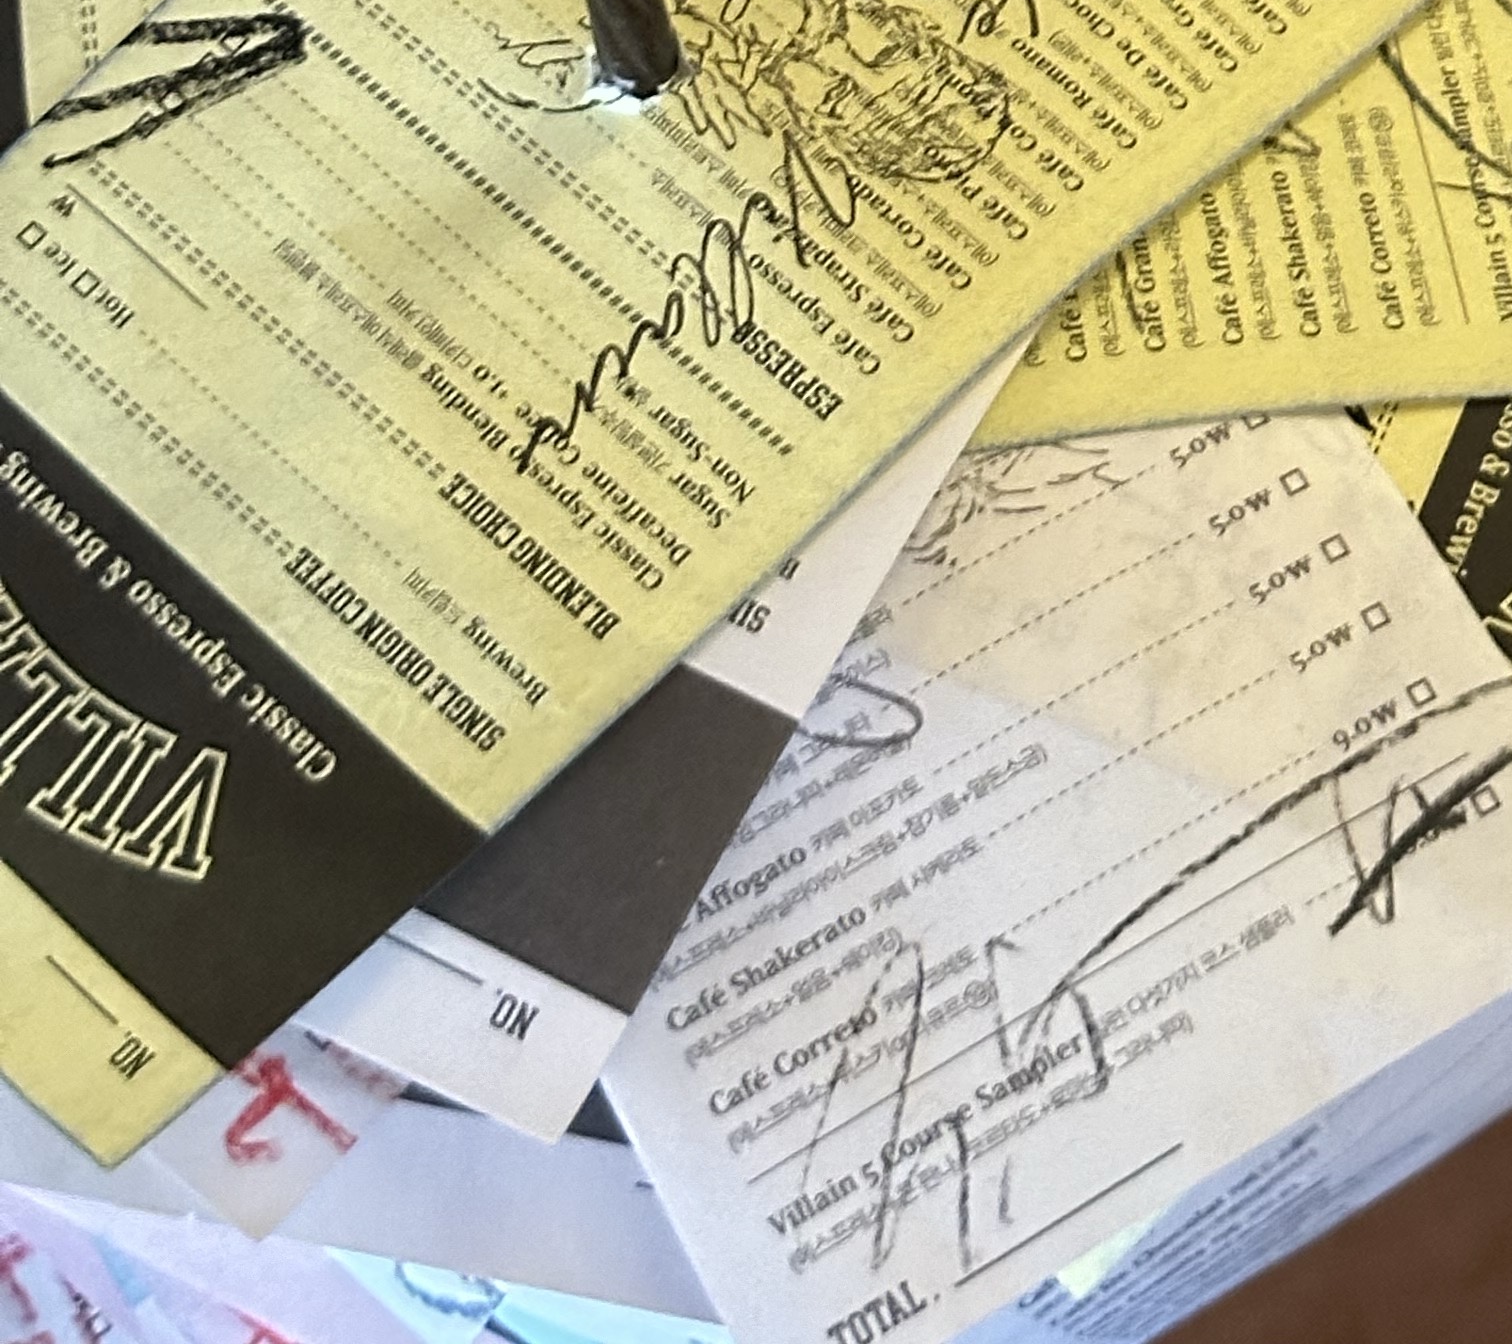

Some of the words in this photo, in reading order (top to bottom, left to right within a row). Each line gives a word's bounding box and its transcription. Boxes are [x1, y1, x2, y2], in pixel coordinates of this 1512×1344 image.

[1006, 31, 1094, 113] Romano
[1110, 35, 1146, 70] De
[1138, 62, 1193, 113] Café
[1188, 25, 1242, 77] Café
[1086, 103, 1140, 154] Café
[1032, 144, 1087, 197] Café
[1462, 151, 1500, 230] Course
[840, 169, 930, 253] Cortado
[977, 193, 1032, 245] Café
[1192, 189, 1238, 290] Affogato
[1267, 168, 1312, 283] Shakerato
[1355, 189, 1394, 276] Correto
[1485, 230, 1505, 246] 5
[37, 237, 80, 279] Ice
[743, 245, 840, 336] Espresso
[919, 241, 975, 295] Café
[1121, 230, 1158, 296] Gran
[88, 283, 137, 331] Hot
[861, 292, 918, 348] Café
[1135, 298, 1169, 355] Café
[1214, 290, 1248, 347] Café
[1289, 284, 1324, 339] Café
[1374, 275, 1408, 332] Café
[728, 314, 844, 423] ESPRESSO
[828, 324, 885, 379] Café
[414, 358, 515, 452] Blending
[1166, 416, 1237, 471] 5.0W
[501, 436, 601, 530] Espresso
[643, 396, 760, 505] Non-Sugar
[0, 449, 109, 571] Brewing
[436, 469, 524, 552] CHOICE
[574, 457, 694, 568] Decaffeine
[662, 463, 734, 531] Sugar
[1205, 483, 1279, 539] 5.0W
[100, 555, 133, 591] &
[281, 542, 370, 628] COFFEE
[506, 532, 623, 642] BLENDING
[587, 517, 668, 594] Classic
[129, 579, 247, 698] Espresso
[351, 607, 438, 690] ORIGIN
[454, 612, 555, 708] Brewing
[241, 685, 338, 782] Classic
[419, 670, 509, 755] SINGLE
[687, 838, 810, 924] Affogato
[1246, 551, 1320, 607] 5.0W
[660, 980, 731, 1034] Café
[725, 900, 870, 998] Shakerato
[1286, 619, 1359, 675] 5.0W
[709, 1063, 773, 1118] Café
[768, 1001, 882, 1081] Correto
[1328, 695, 1405, 754] 9.0W
[480, 985, 542, 1042] NO.
[764, 1167, 862, 1240] Villain
[857, 1158, 885, 1189] 5
[970, 1029, 1090, 1114] Sampler
